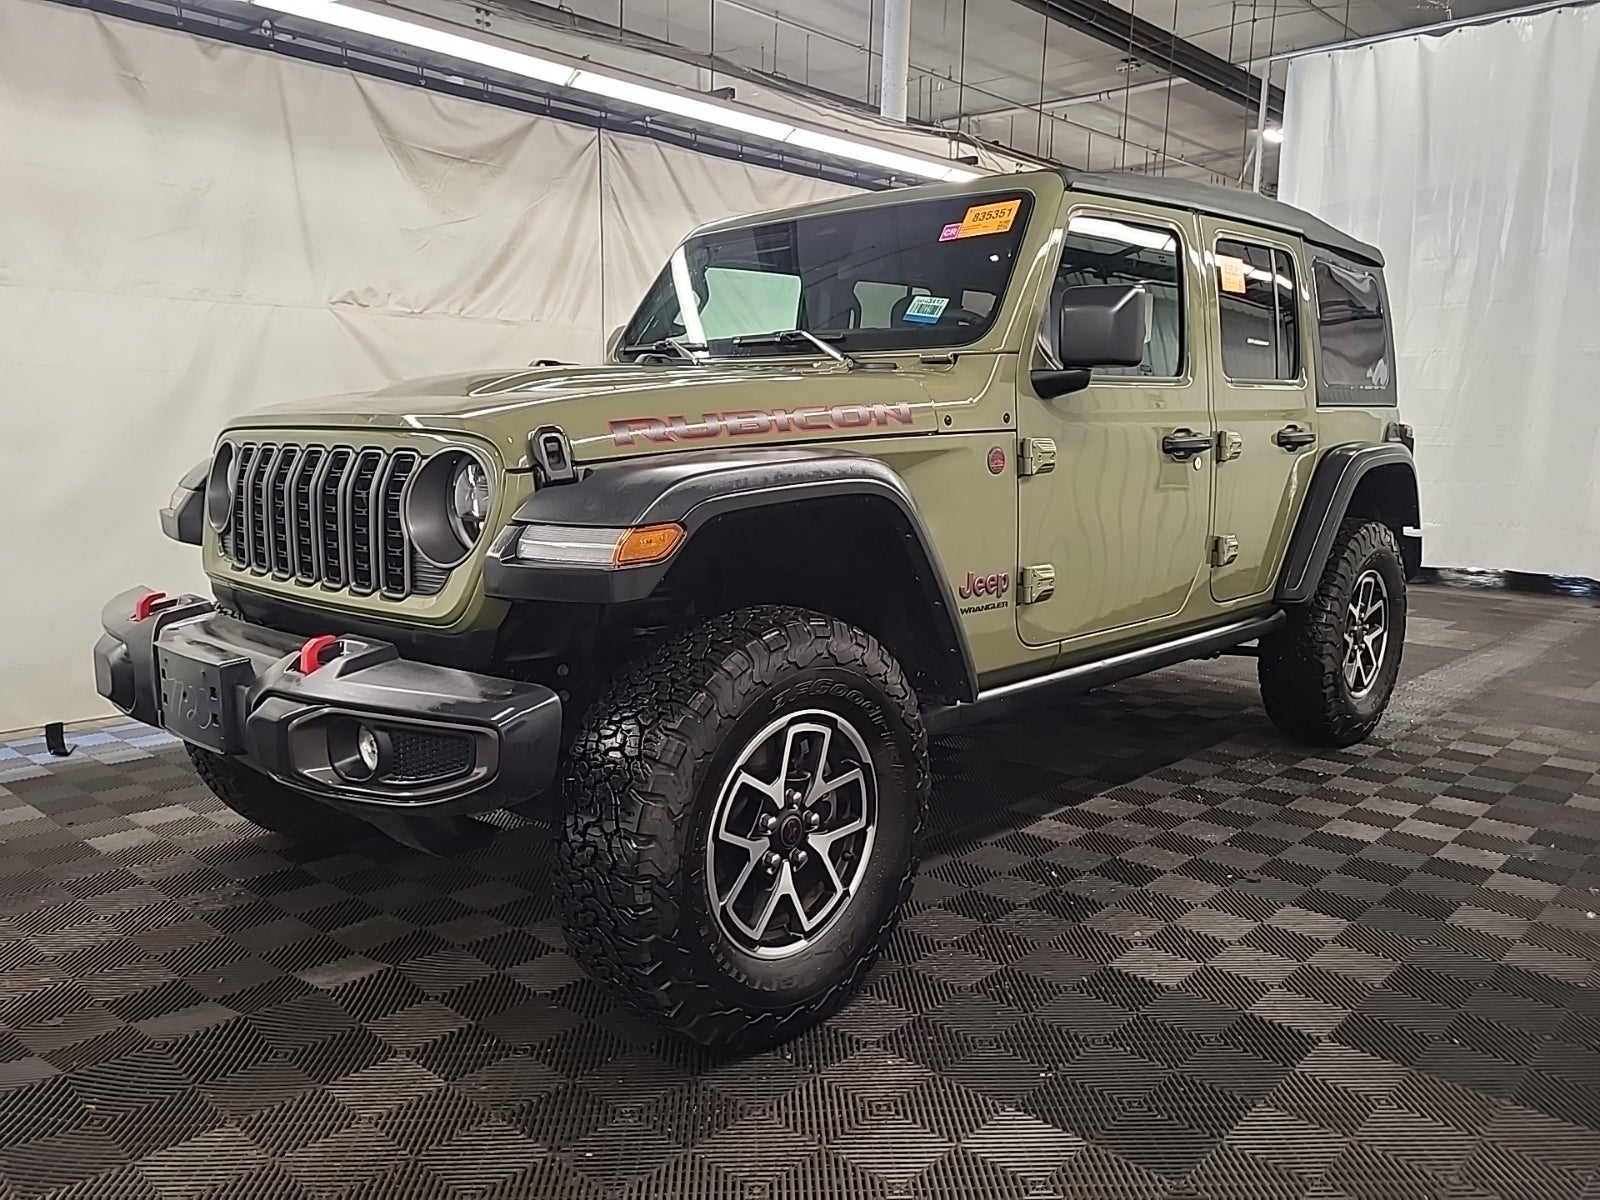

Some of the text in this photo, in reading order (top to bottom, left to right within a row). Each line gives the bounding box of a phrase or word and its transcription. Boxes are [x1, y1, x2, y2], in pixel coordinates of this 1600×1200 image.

[972, 208, 1013, 222] 835351
[943, 228, 957, 237] CR
[608, 400, 913, 447] RUBICON
[959, 571, 1009, 599] Jeep
[960, 601, 1008, 615] WRANGLER
